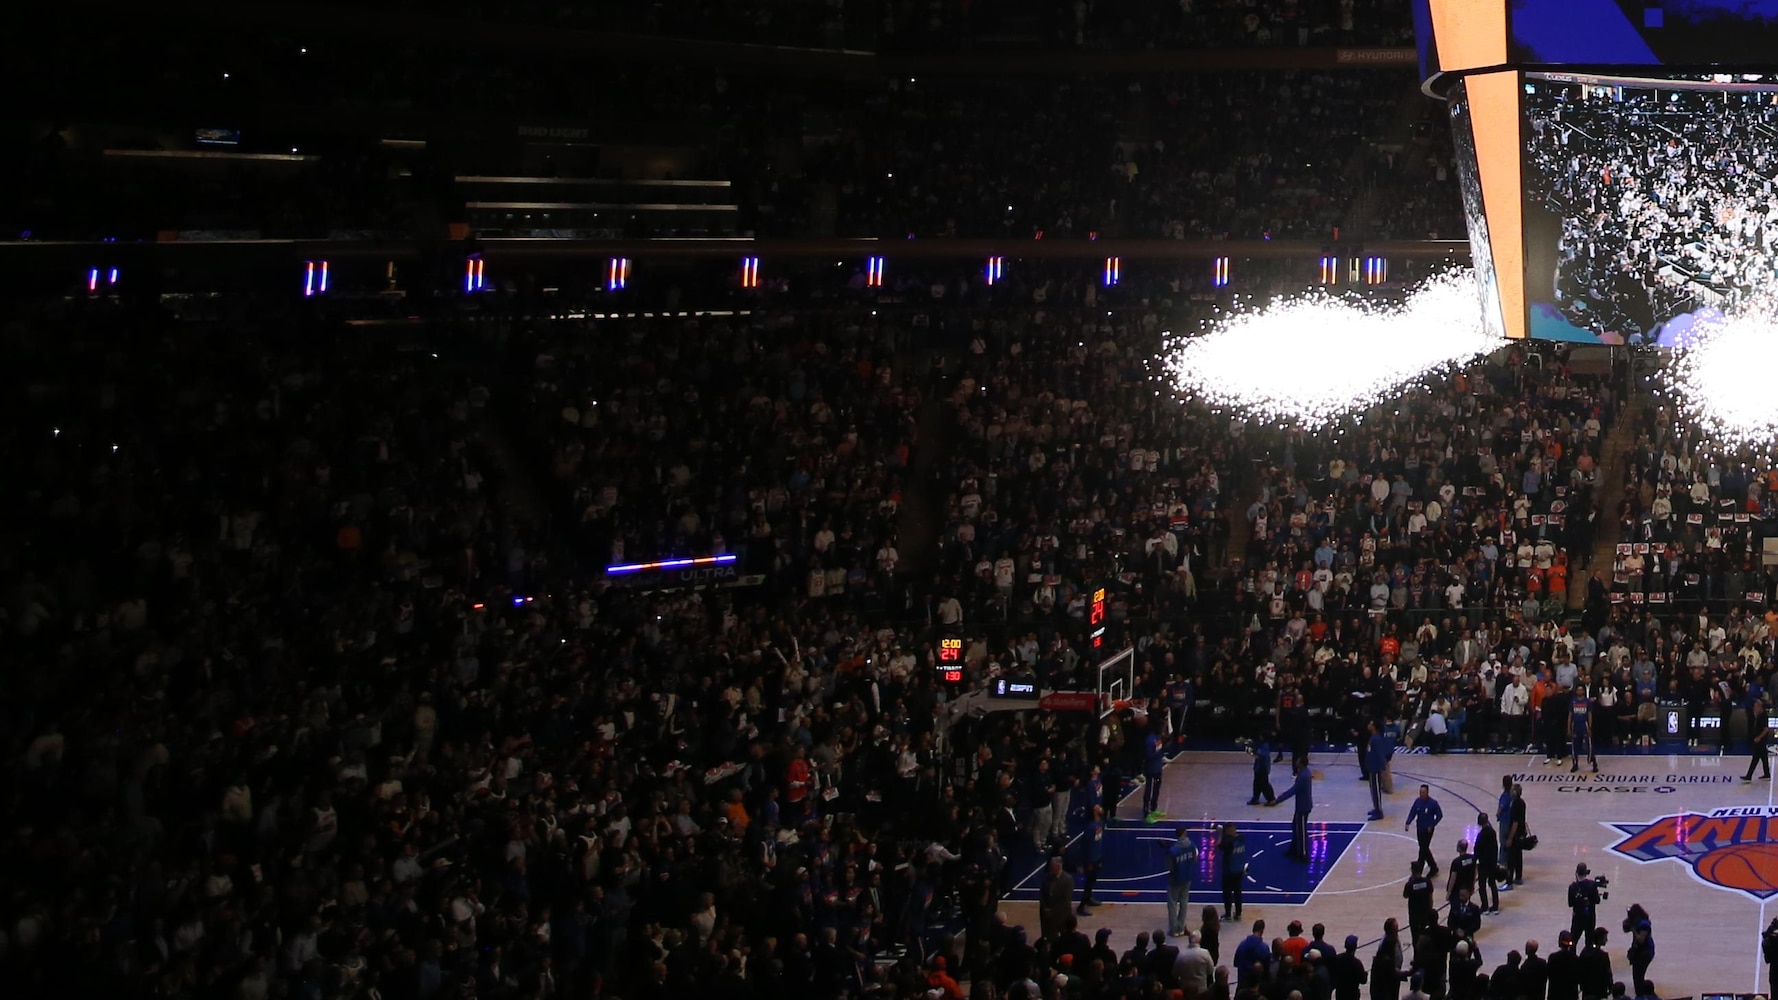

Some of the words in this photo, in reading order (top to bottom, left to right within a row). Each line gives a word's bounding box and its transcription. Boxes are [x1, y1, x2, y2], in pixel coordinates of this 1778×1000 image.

[680, 565, 737, 582] ULTRA
[941, 639, 962, 649] 12:00
[940, 649, 959, 661] 24
[1510, 773, 1588, 783] MADISON
[1593, 774, 1660, 784] SQUARE
[1666, 774, 1733, 784] GARDEN
[1711, 807, 1762, 817] NEW
